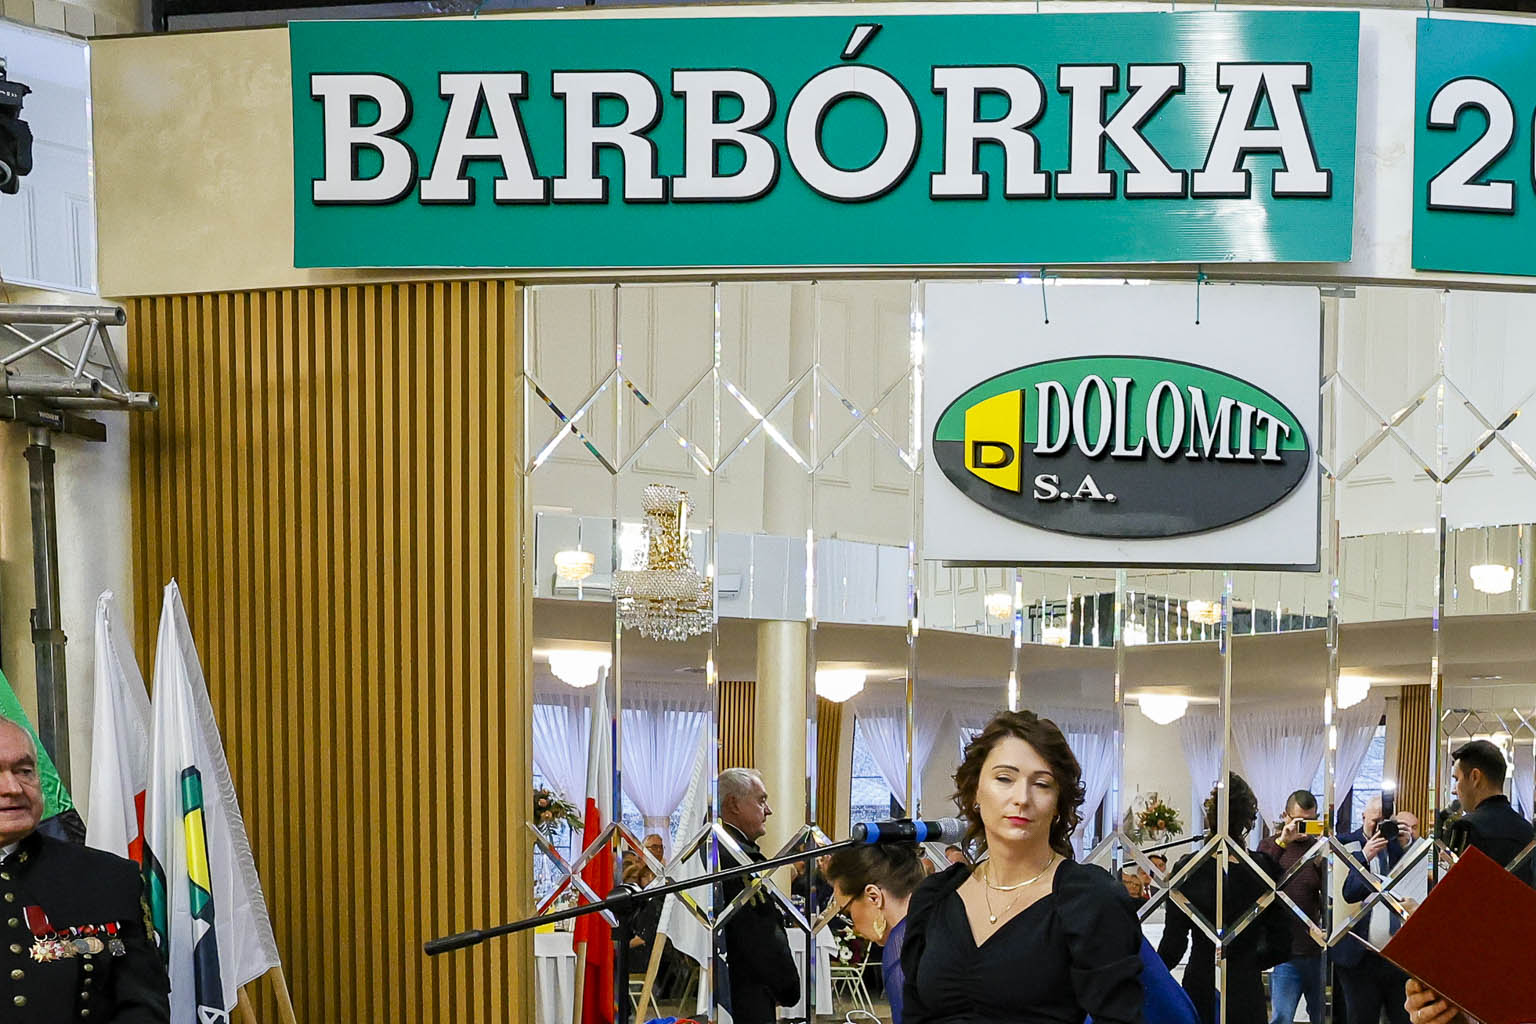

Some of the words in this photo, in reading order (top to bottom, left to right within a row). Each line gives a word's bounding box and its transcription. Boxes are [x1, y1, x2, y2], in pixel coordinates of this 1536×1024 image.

[309, 23, 1332, 206] BARBÓRKA
[1032, 374, 1290, 463] DOLOMIT
[1032, 473, 1117, 503] S.A.
